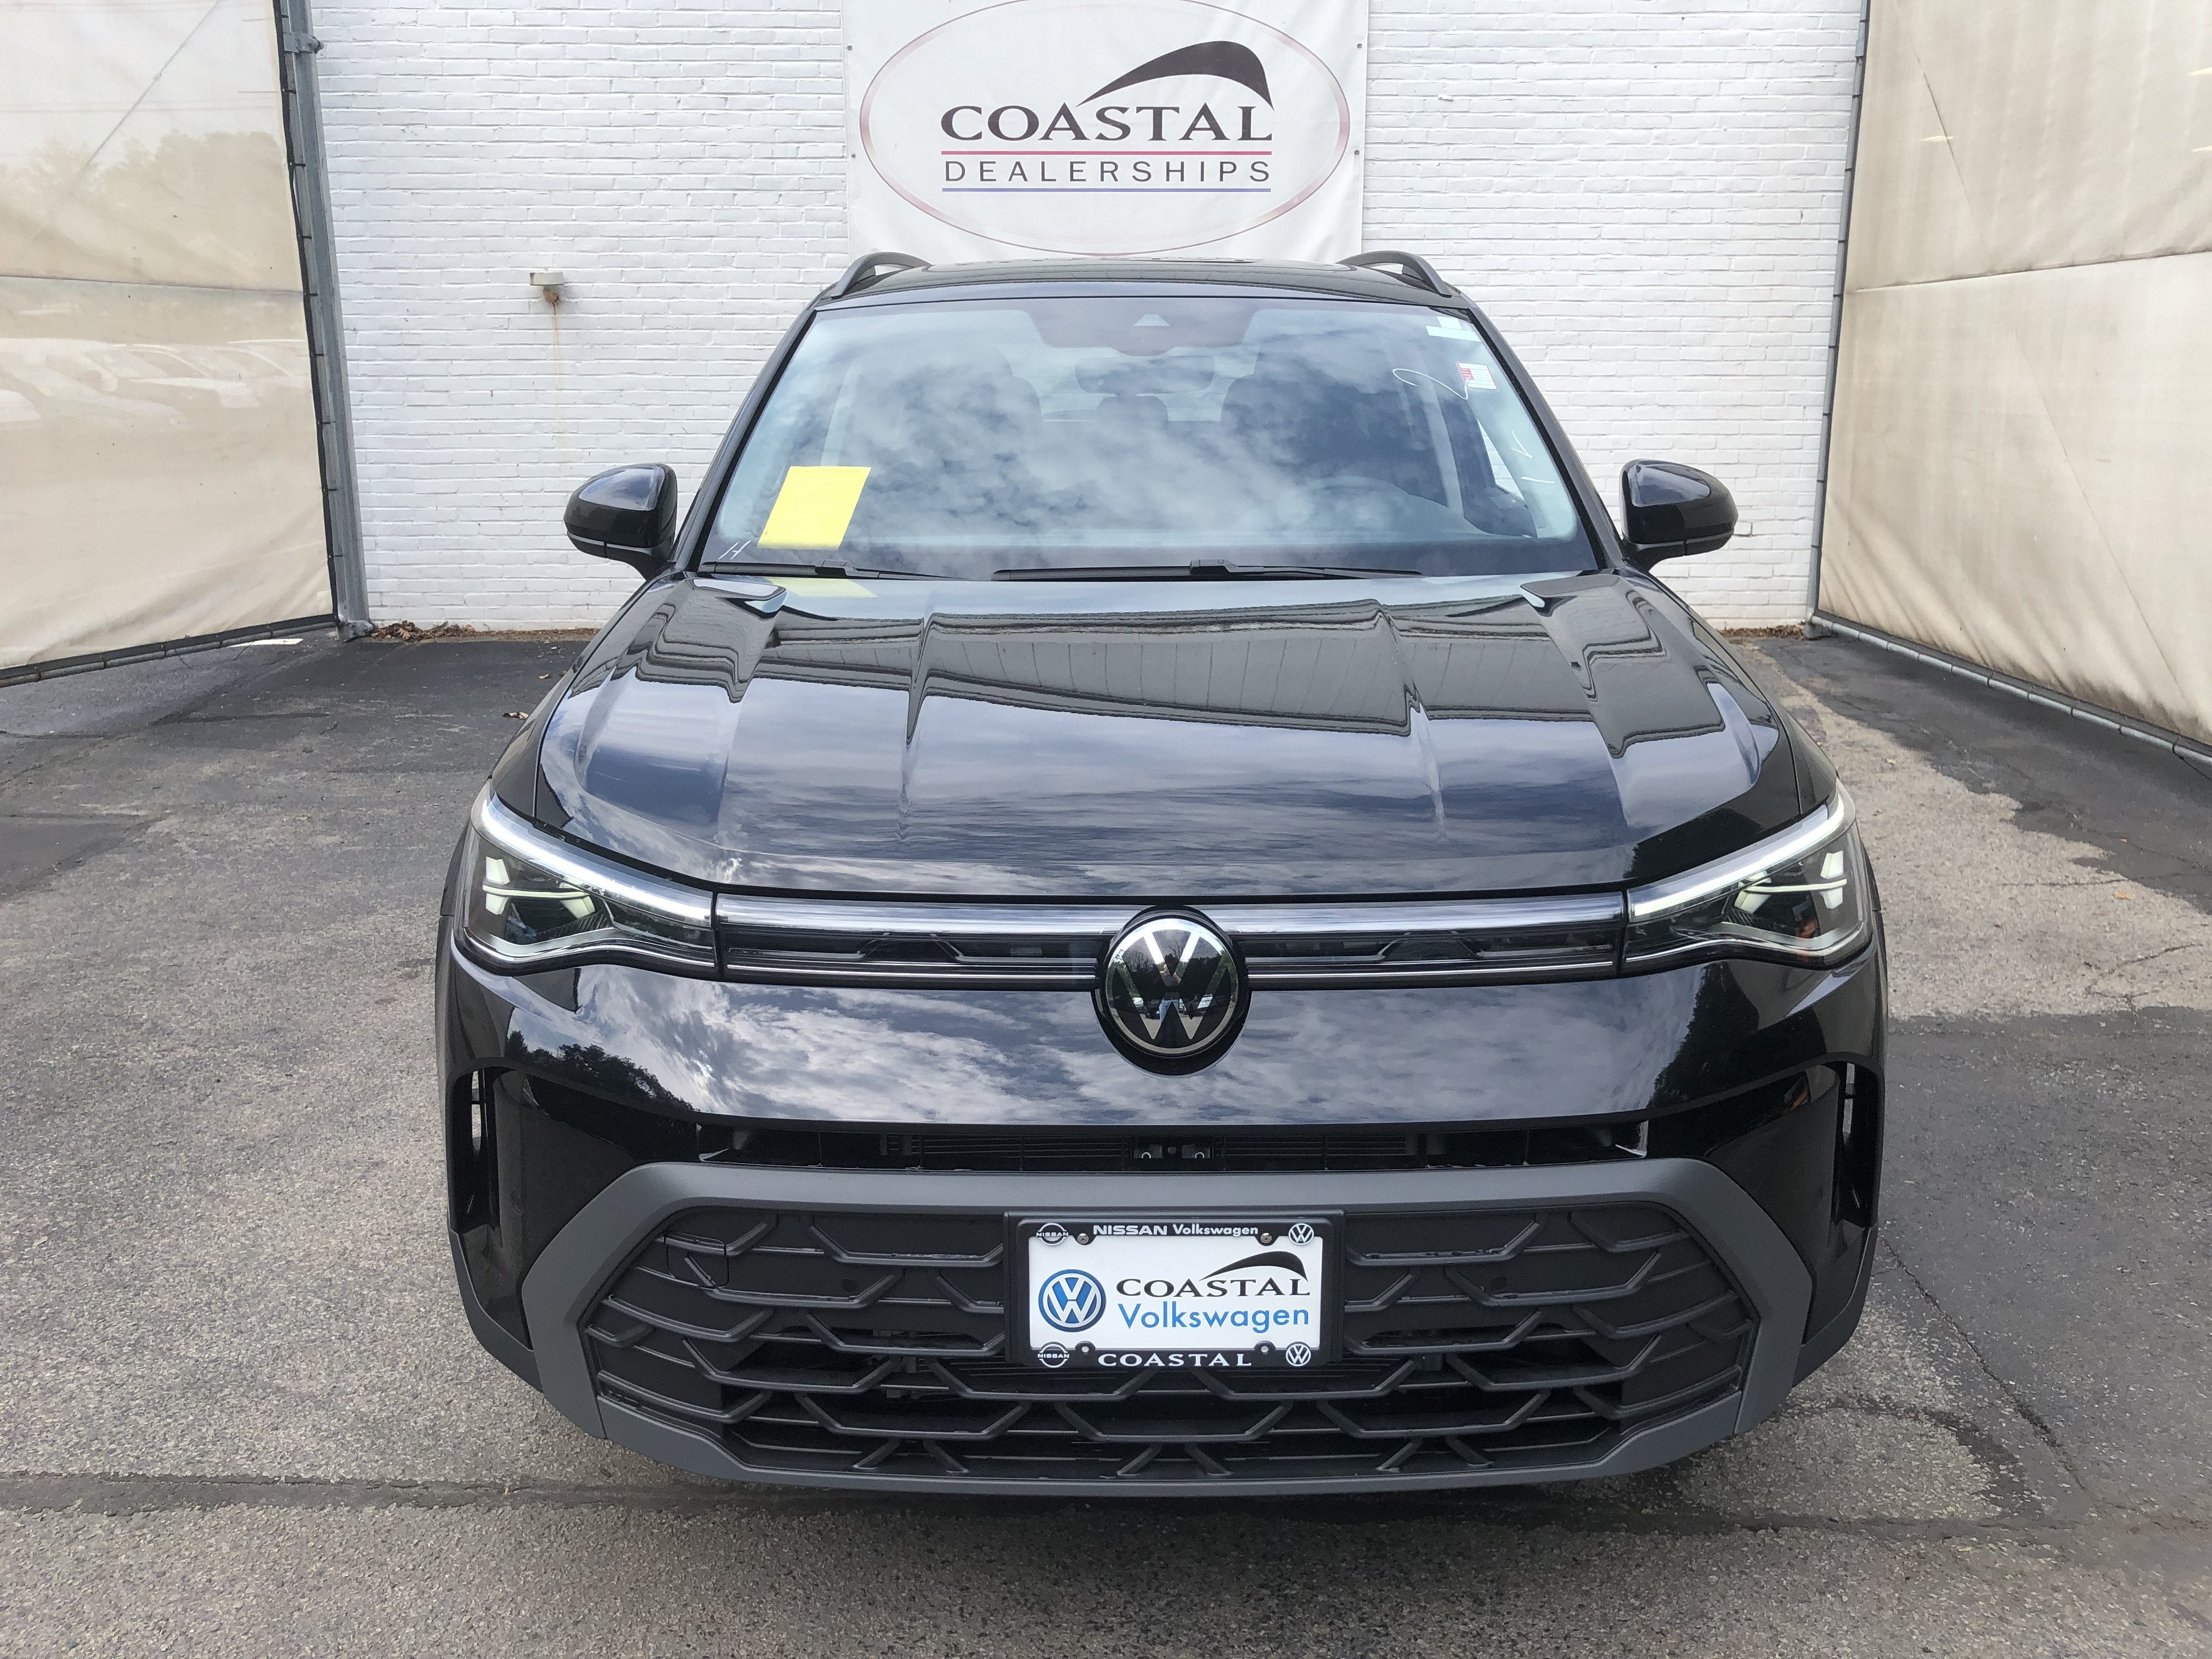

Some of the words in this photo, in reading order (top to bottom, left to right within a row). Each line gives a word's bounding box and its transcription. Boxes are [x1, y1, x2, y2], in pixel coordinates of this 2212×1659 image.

[940, 102, 1273, 142] COASTAL
[945, 161, 1271, 183] DEALERSHIPS
[1107, 927, 1238, 1040] VW
[1093, 1225, 1167, 1235] NISSAN
[1173, 1224, 1259, 1237] Volkswagen
[1289, 1224, 1313, 1244] VW
[1116, 1278, 1311, 1298] COASTAL
[1045, 1275, 1100, 1325] VW
[1118, 1301, 1309, 1334] Volkswagen
[1098, 1353, 1251, 1367] COASTAL
[1286, 1344, 1311, 1365] VW
